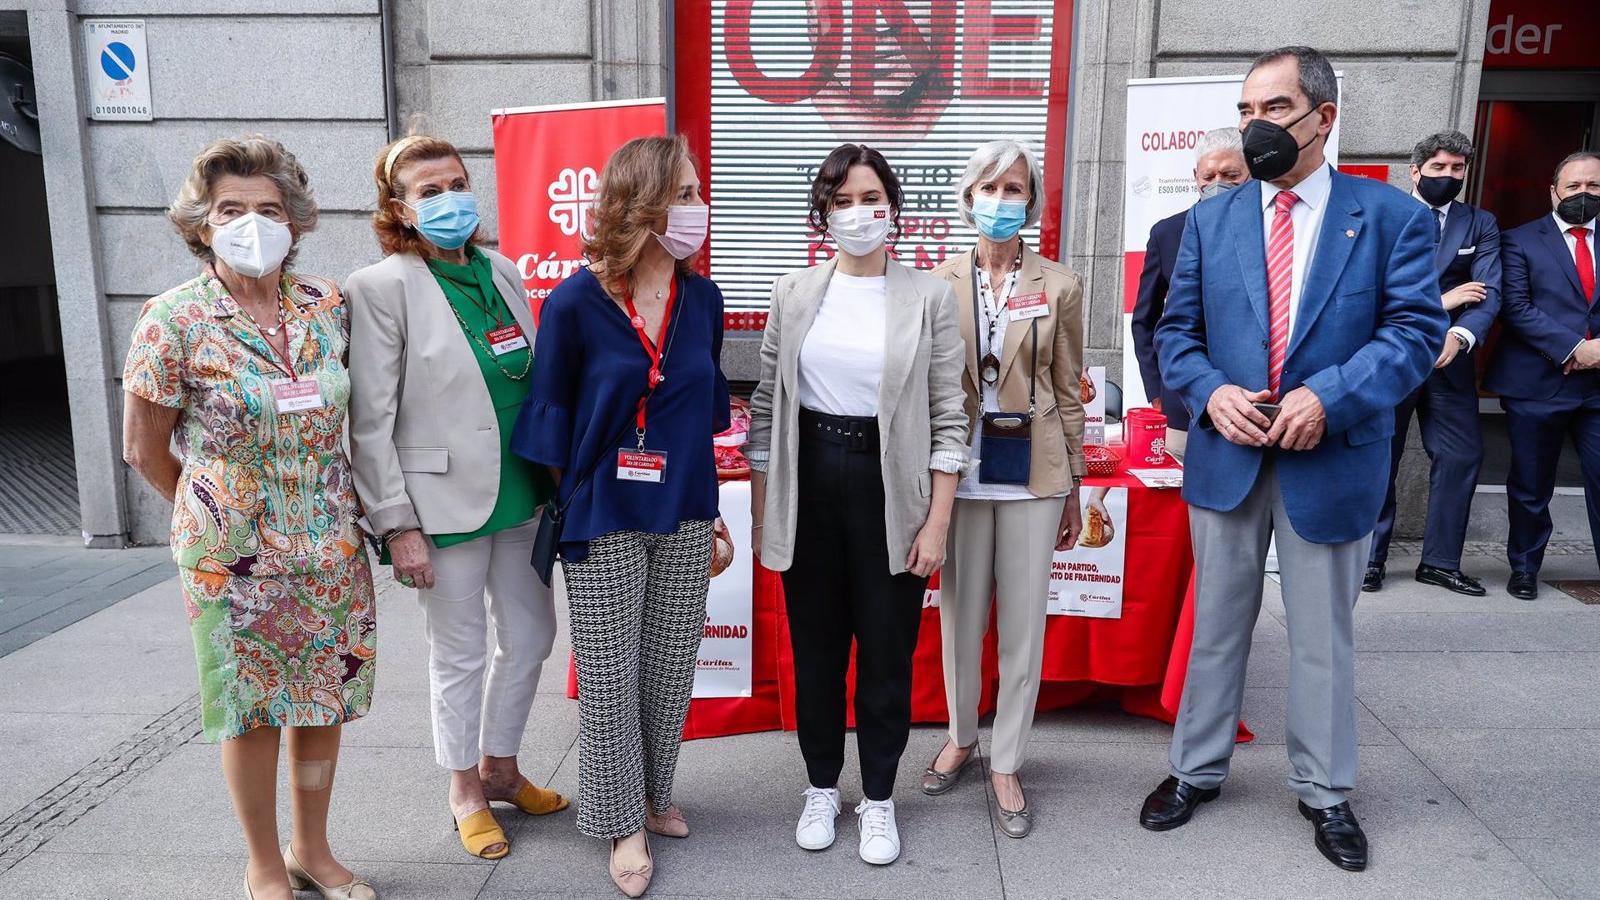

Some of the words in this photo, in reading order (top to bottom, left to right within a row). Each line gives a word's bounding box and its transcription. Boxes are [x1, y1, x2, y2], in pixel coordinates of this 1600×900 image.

[1486, 14, 1563, 55] der
[96, 106, 147, 114] 0100001046
[1052, 562, 1066, 570] PAN
[1068, 562, 1099, 573] PARTIDO,
[1064, 573, 1073, 581] DE
[1074, 573, 1121, 584] FRATERNIDAD
